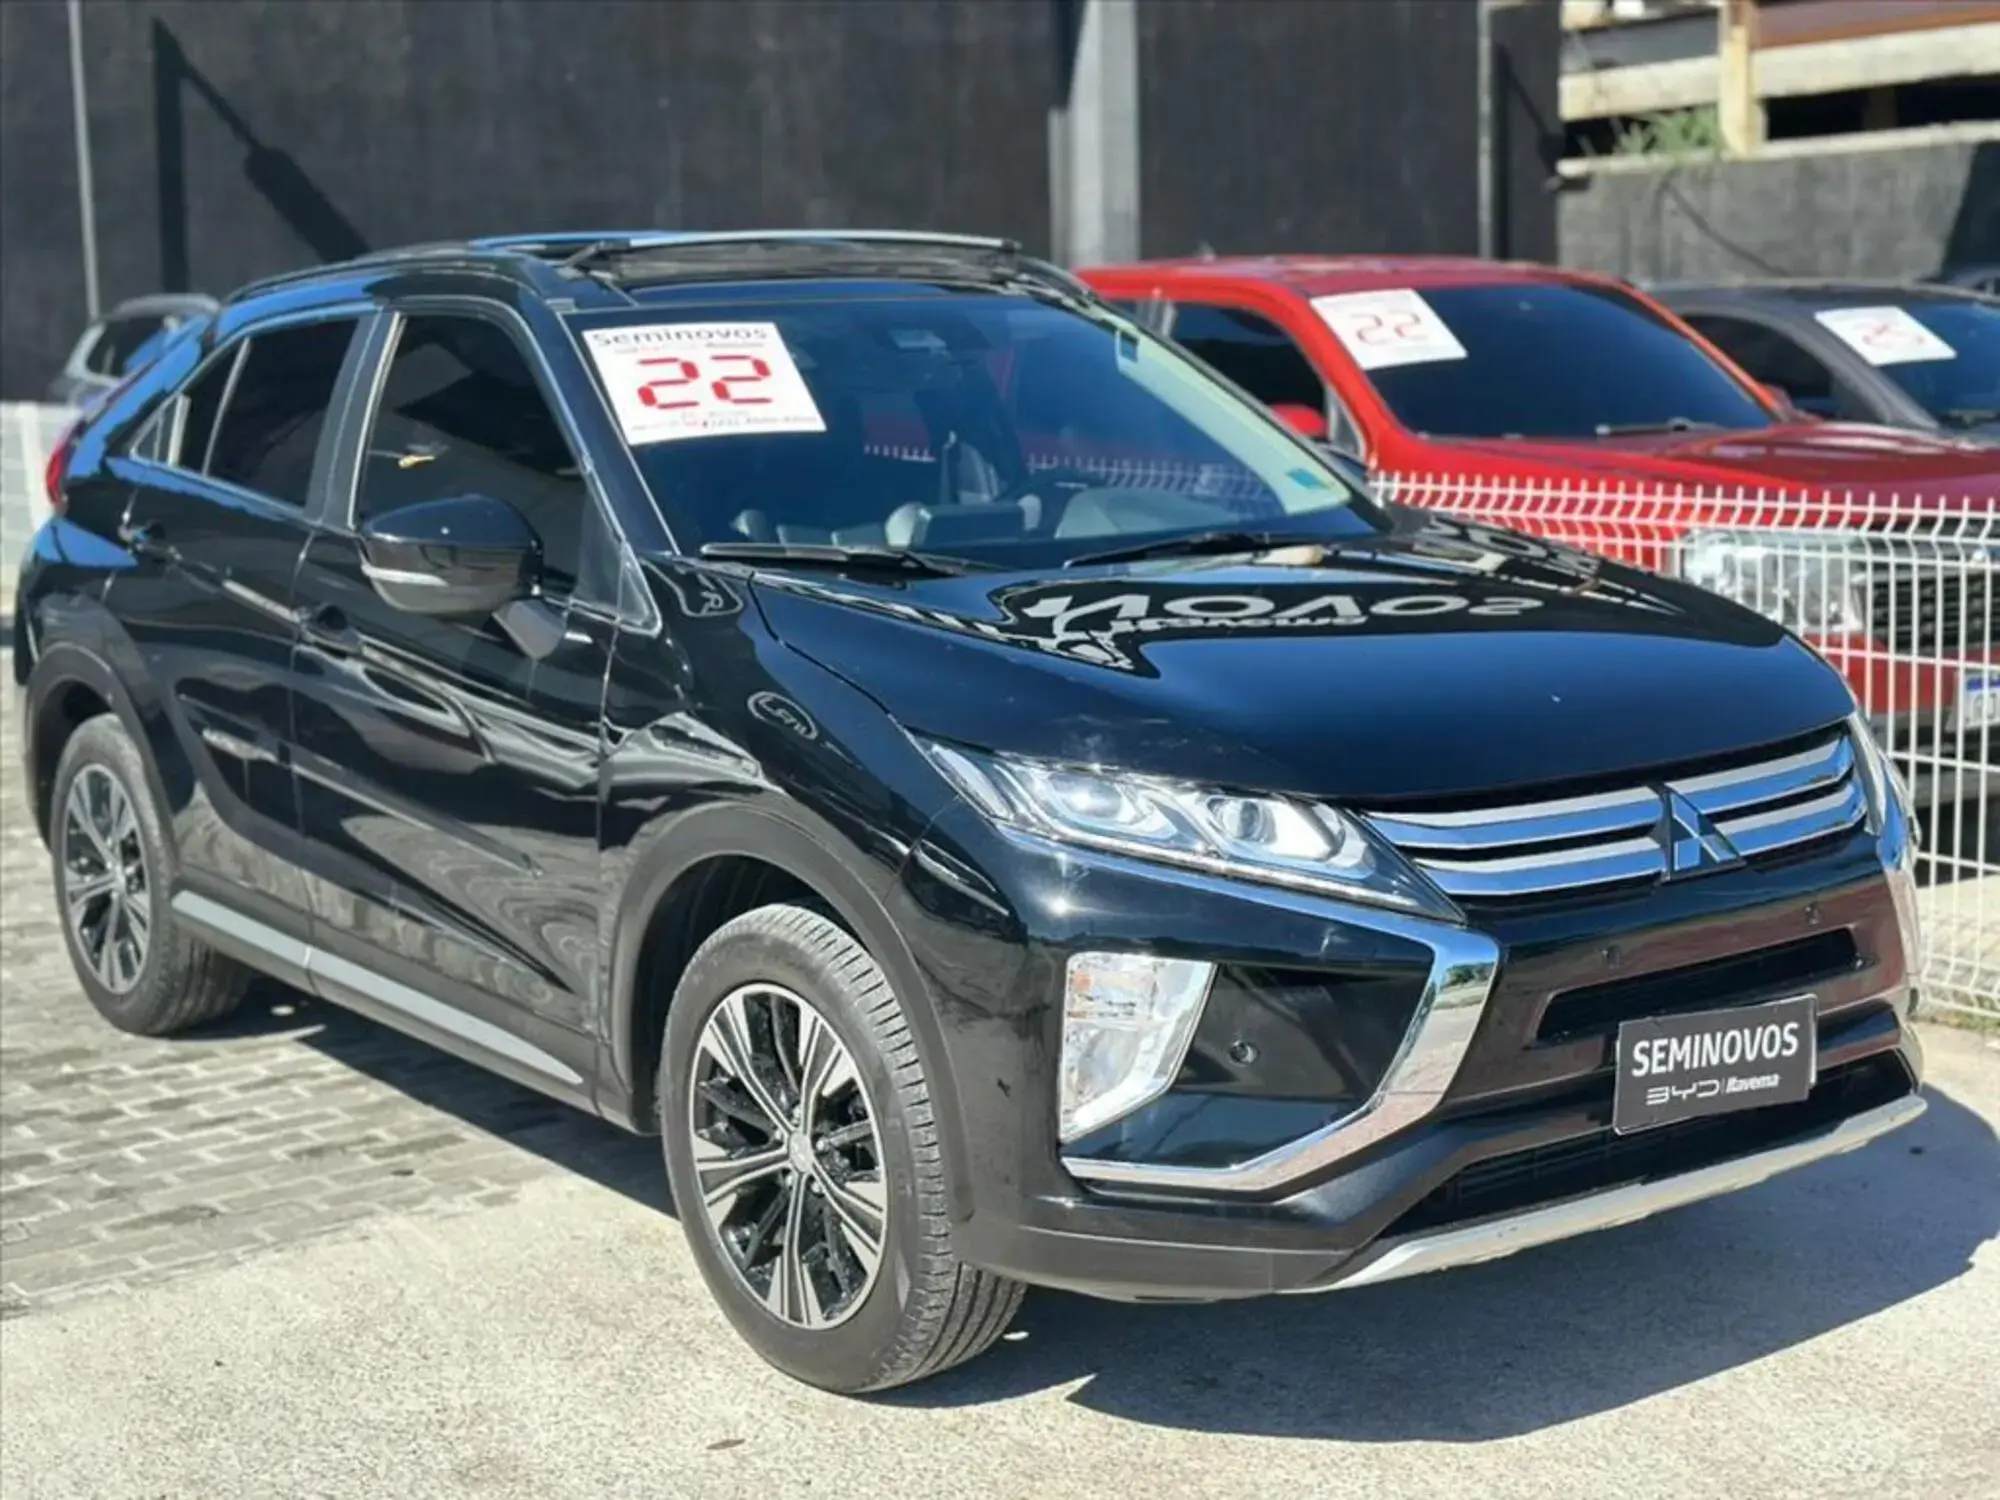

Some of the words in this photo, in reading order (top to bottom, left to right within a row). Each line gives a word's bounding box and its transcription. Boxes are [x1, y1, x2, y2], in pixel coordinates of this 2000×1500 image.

[592, 327, 768, 346] Seminovos
[1350, 309, 1428, 346] 22
[637, 354, 774, 410] 22
[1631, 1022, 1799, 1078] SEMINOVOS
[1645, 1079, 1721, 1106] BYD
